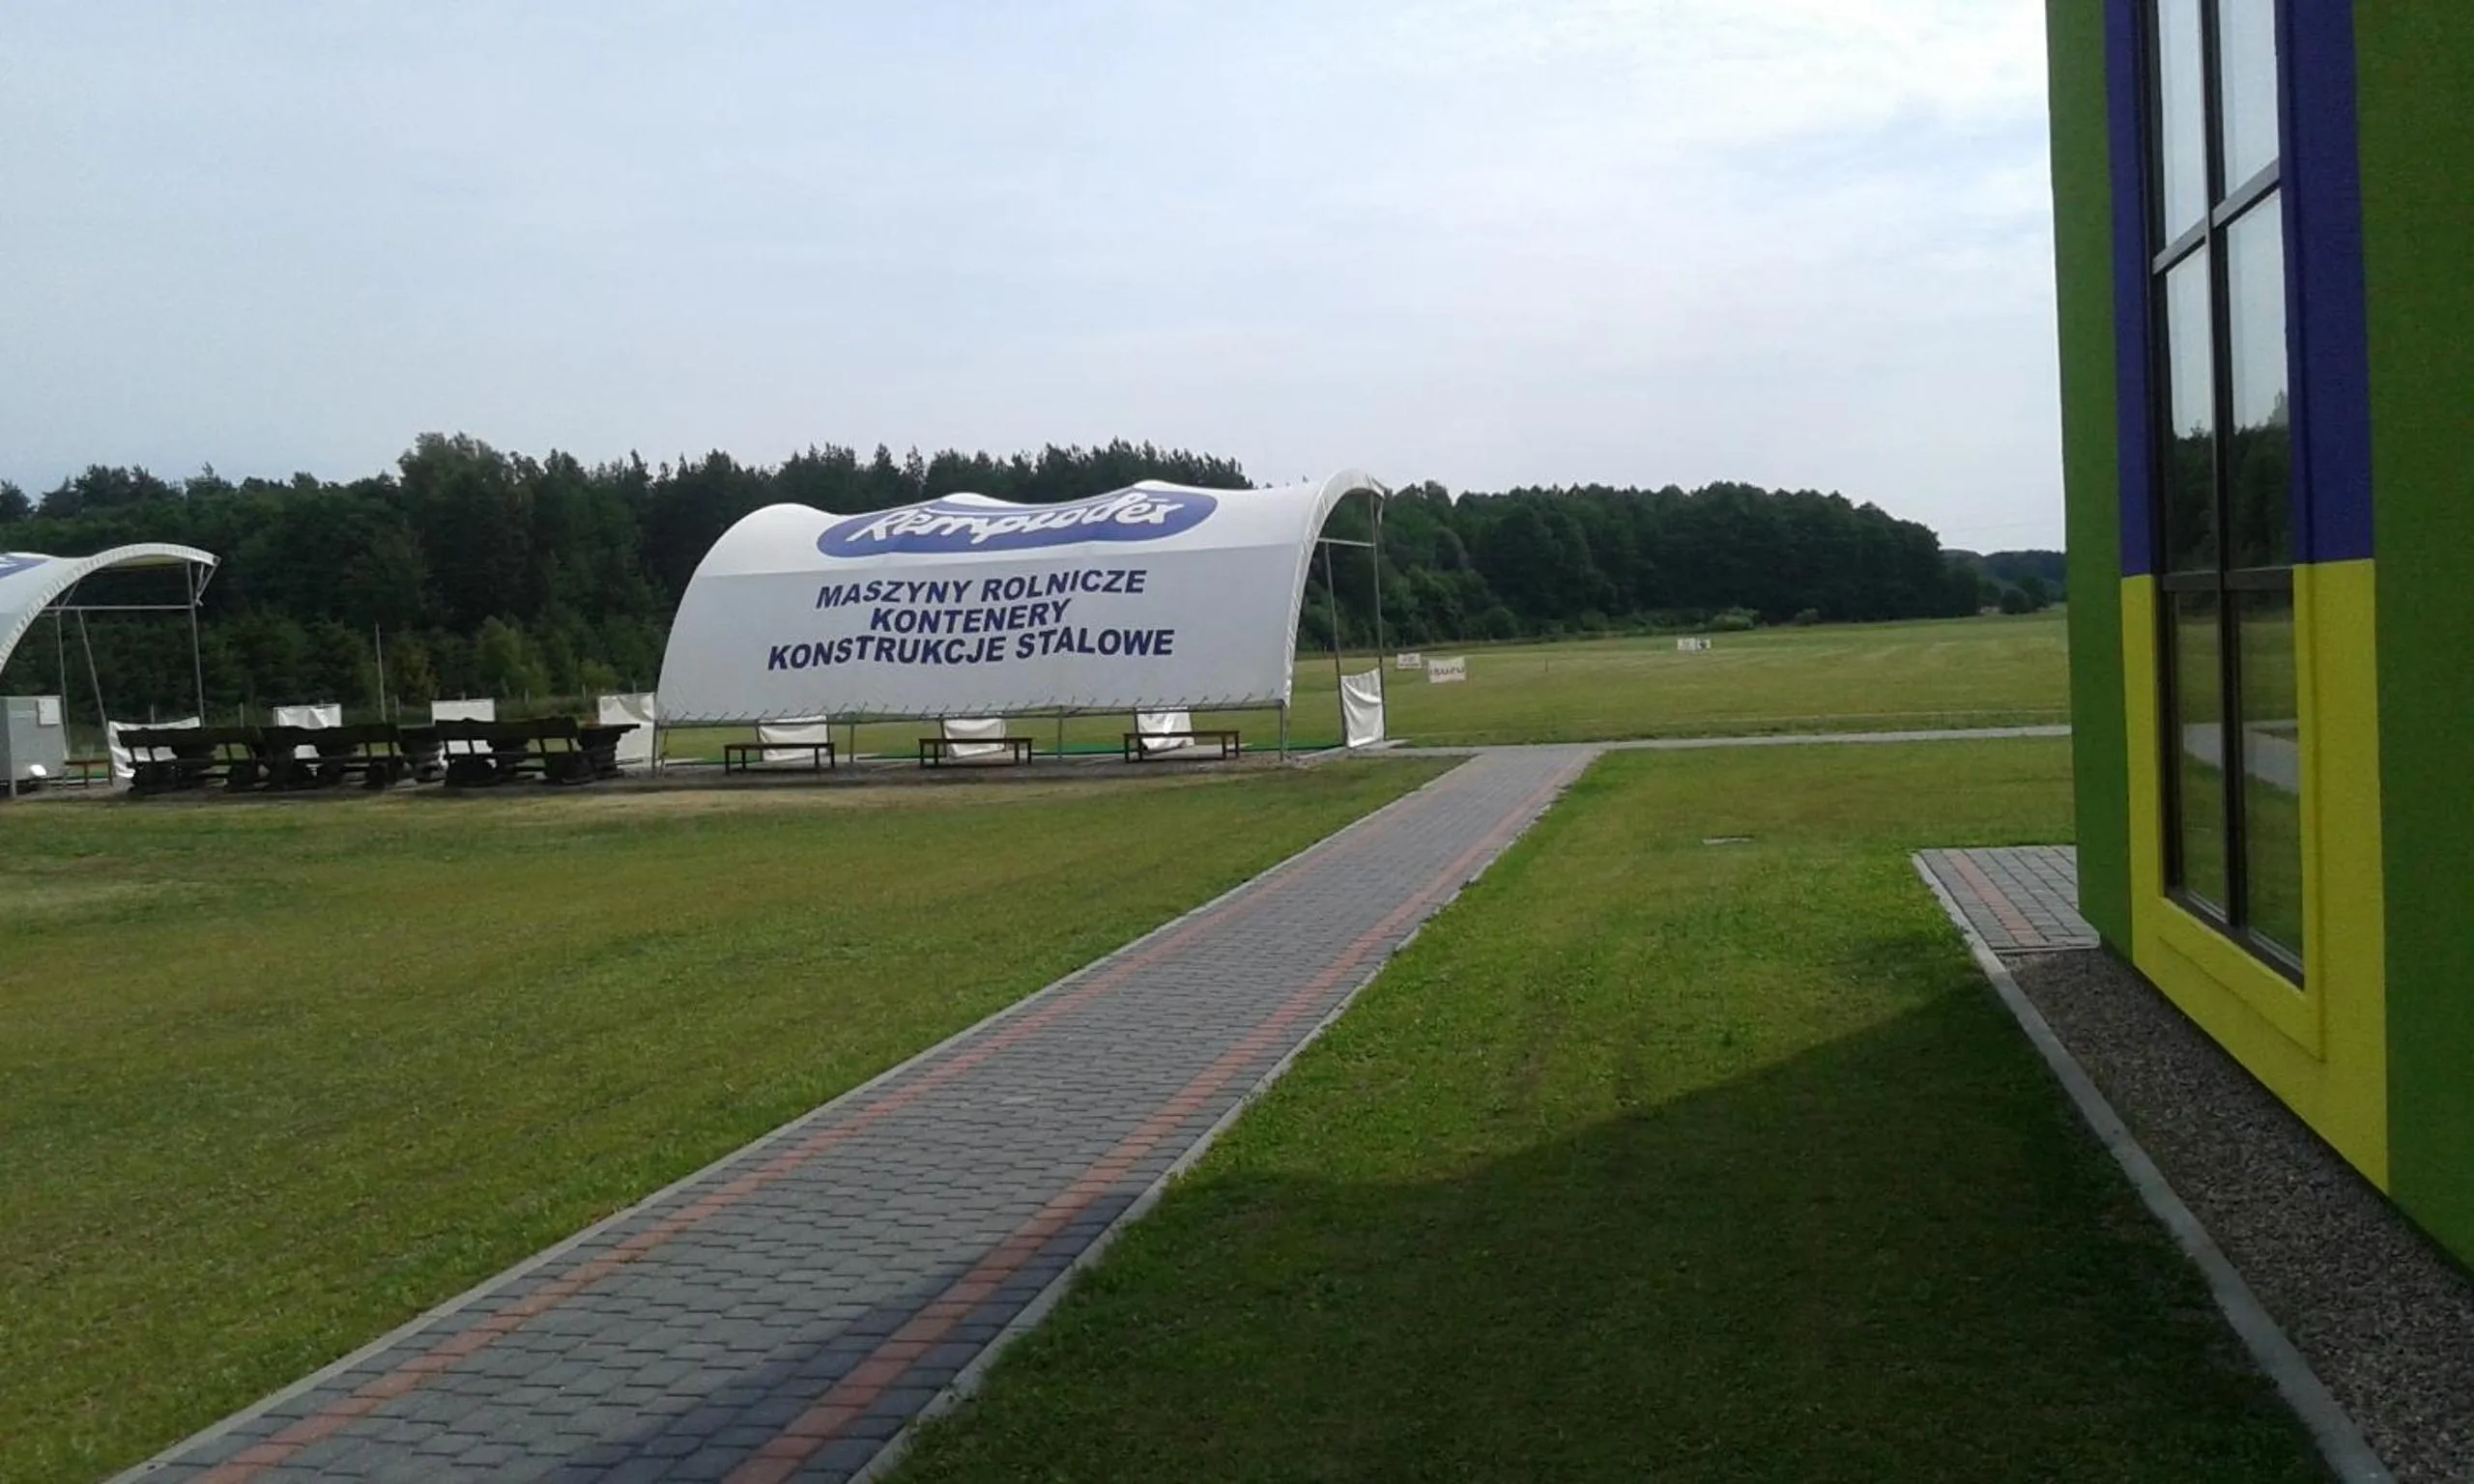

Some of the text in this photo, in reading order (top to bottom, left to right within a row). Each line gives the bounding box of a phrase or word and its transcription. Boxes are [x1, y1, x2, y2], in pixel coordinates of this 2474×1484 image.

[816, 569, 1147, 609] MASZYNY ROLNICZE
[870, 598, 1072, 634] KONTENERY
[767, 626, 1175, 671] KONSTRUKCJE STALOWE
